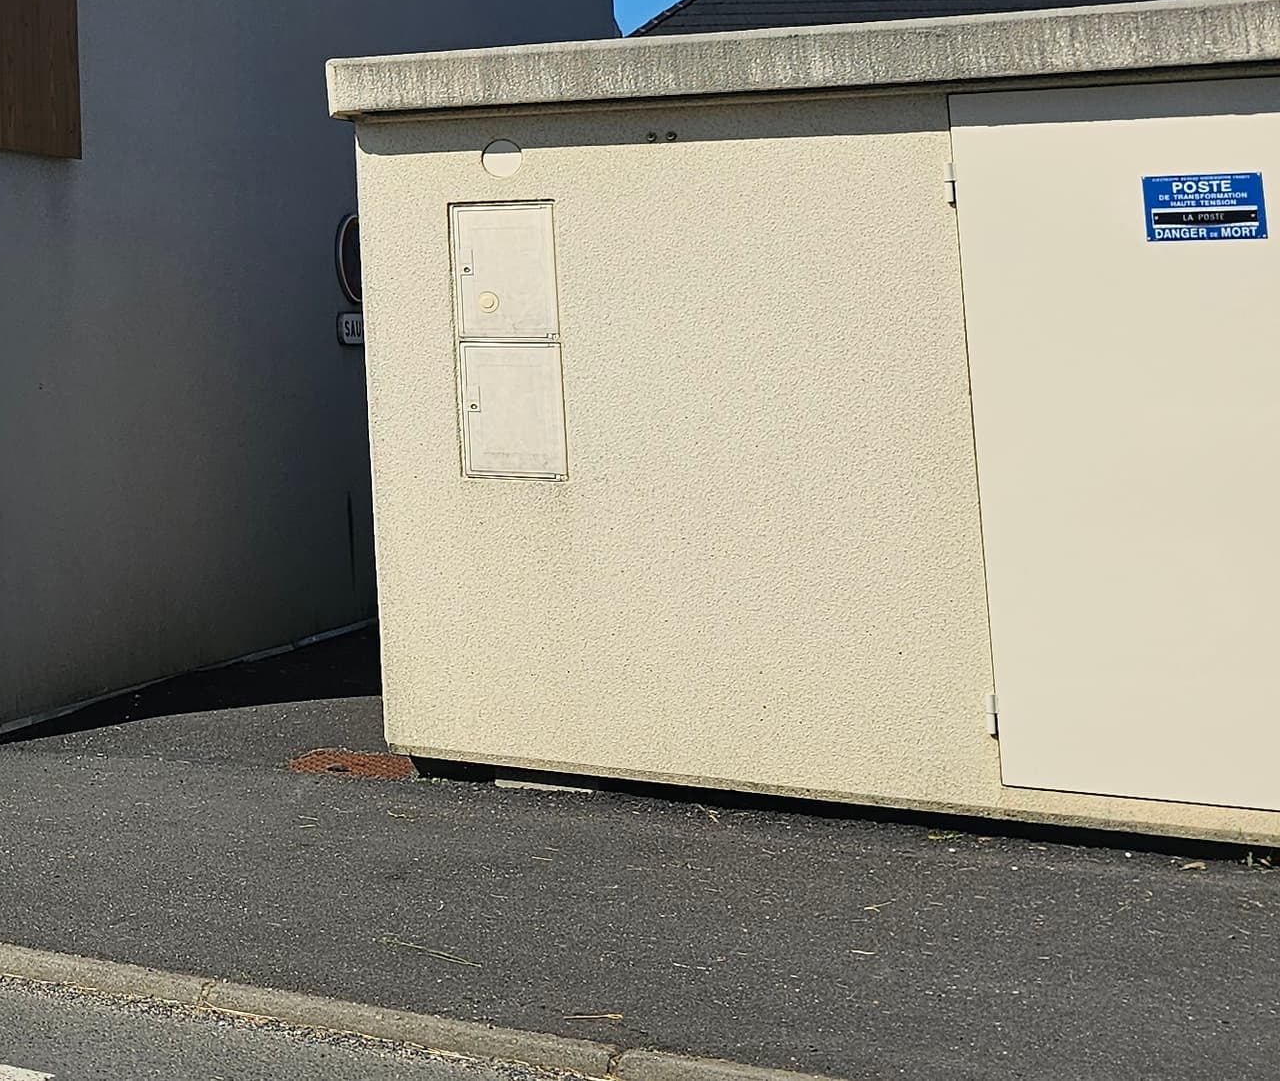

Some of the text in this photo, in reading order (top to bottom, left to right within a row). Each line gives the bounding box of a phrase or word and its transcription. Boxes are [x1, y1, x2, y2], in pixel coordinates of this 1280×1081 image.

[1172, 180, 1232, 194] POSTE
[1173, 192, 1248, 201] TRANSFORMATION
[1155, 228, 1207, 239] DANGER
[1221, 227, 1257, 238] MORT
[344, 320, 362, 337] SAU
